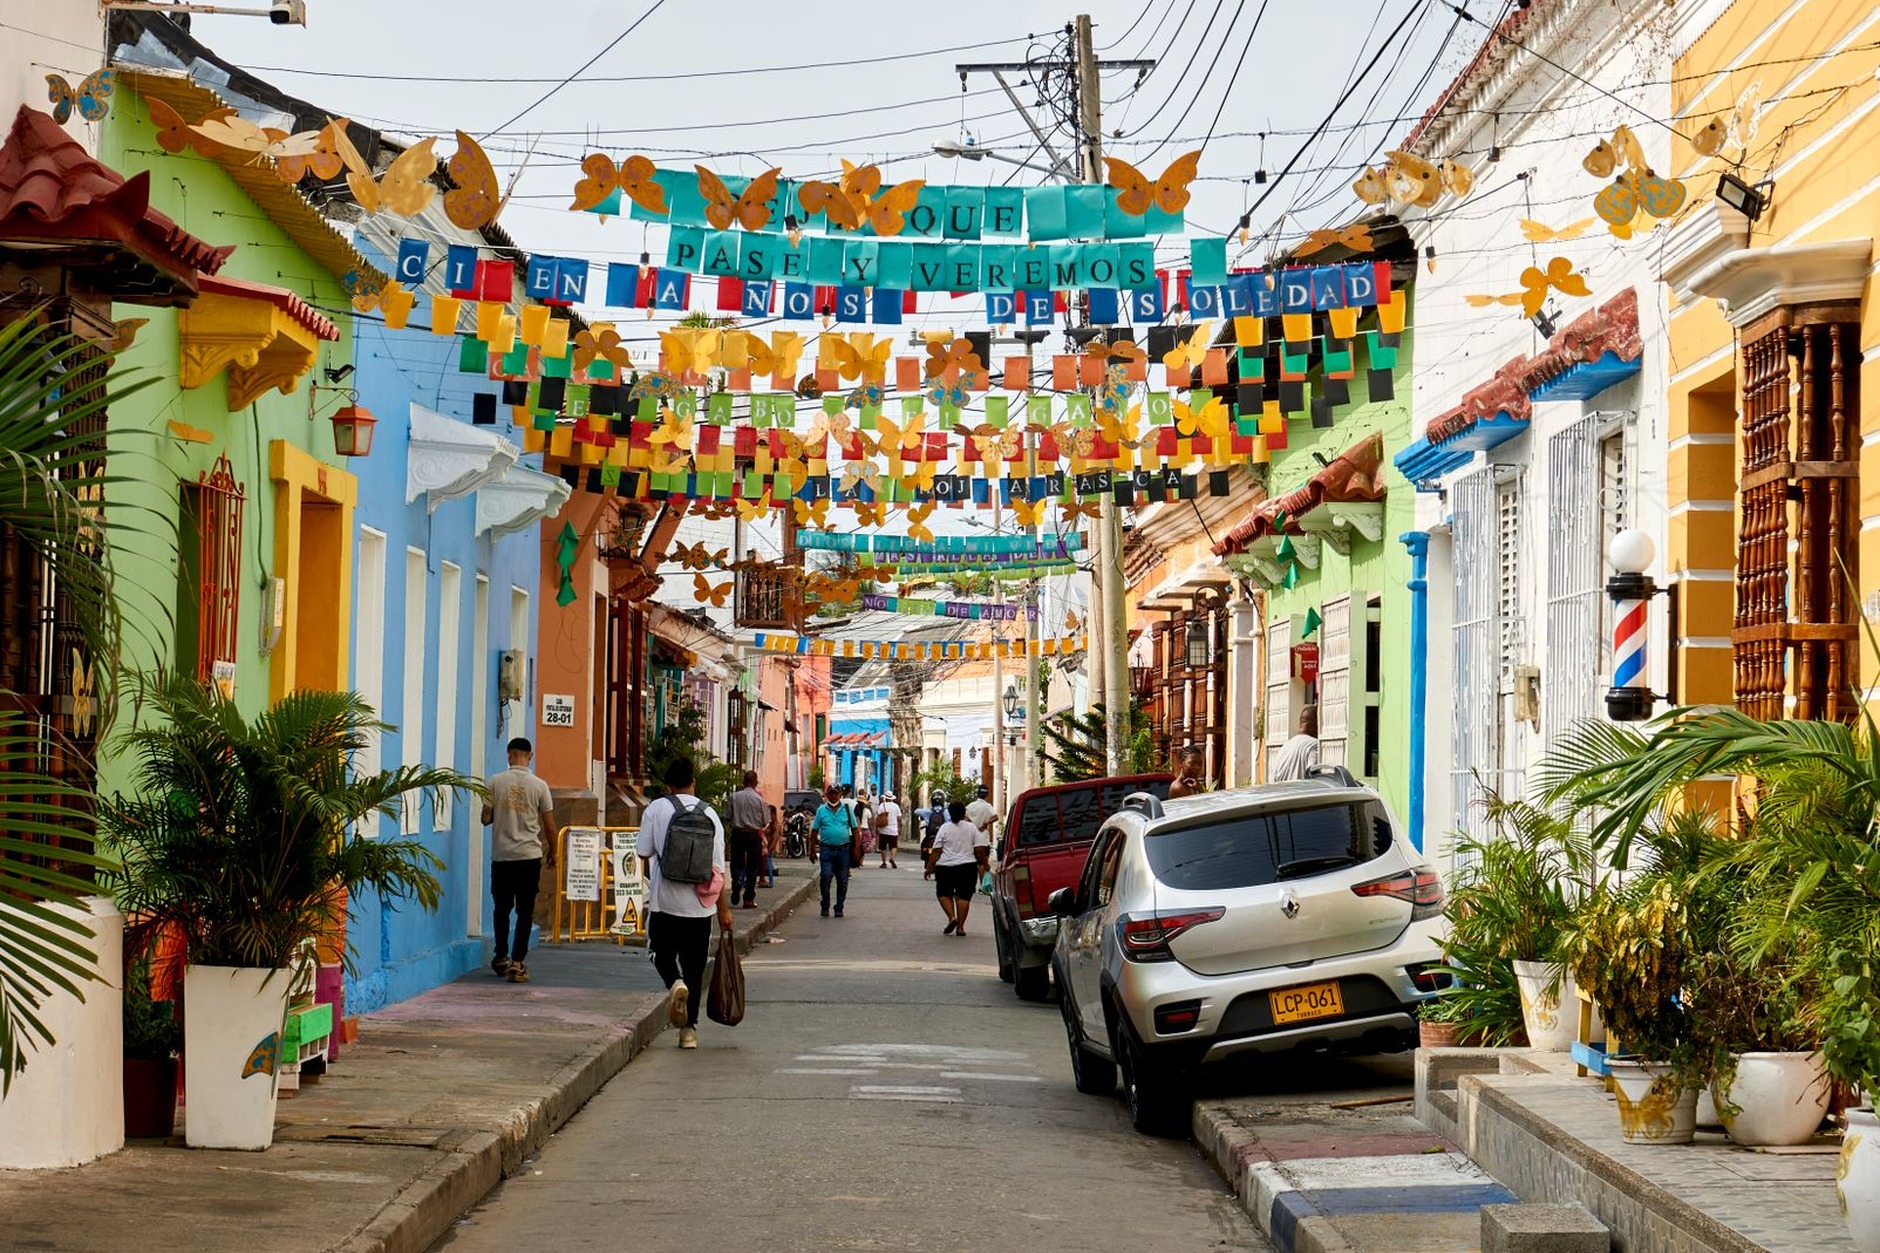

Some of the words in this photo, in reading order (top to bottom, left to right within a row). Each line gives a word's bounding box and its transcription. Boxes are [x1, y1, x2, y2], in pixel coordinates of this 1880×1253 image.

[910, 204, 1015, 235] QUE
[675, 243, 801, 277] PASE
[850, 257, 873, 282] Y
[917, 255, 1146, 288] VEREMOS
[401, 254, 586, 297] CIEN
[991, 297, 1049, 320] DE
[1140, 276, 1372, 317] SOLEDAD
[676, 400, 792, 425] GABO
[1032, 398, 1168, 423] GAO
[816, 483, 858, 498] LA
[947, 606, 968, 617] DE
[981, 609, 1037, 620] AMOR
[546, 712, 571, 724] 28-01
